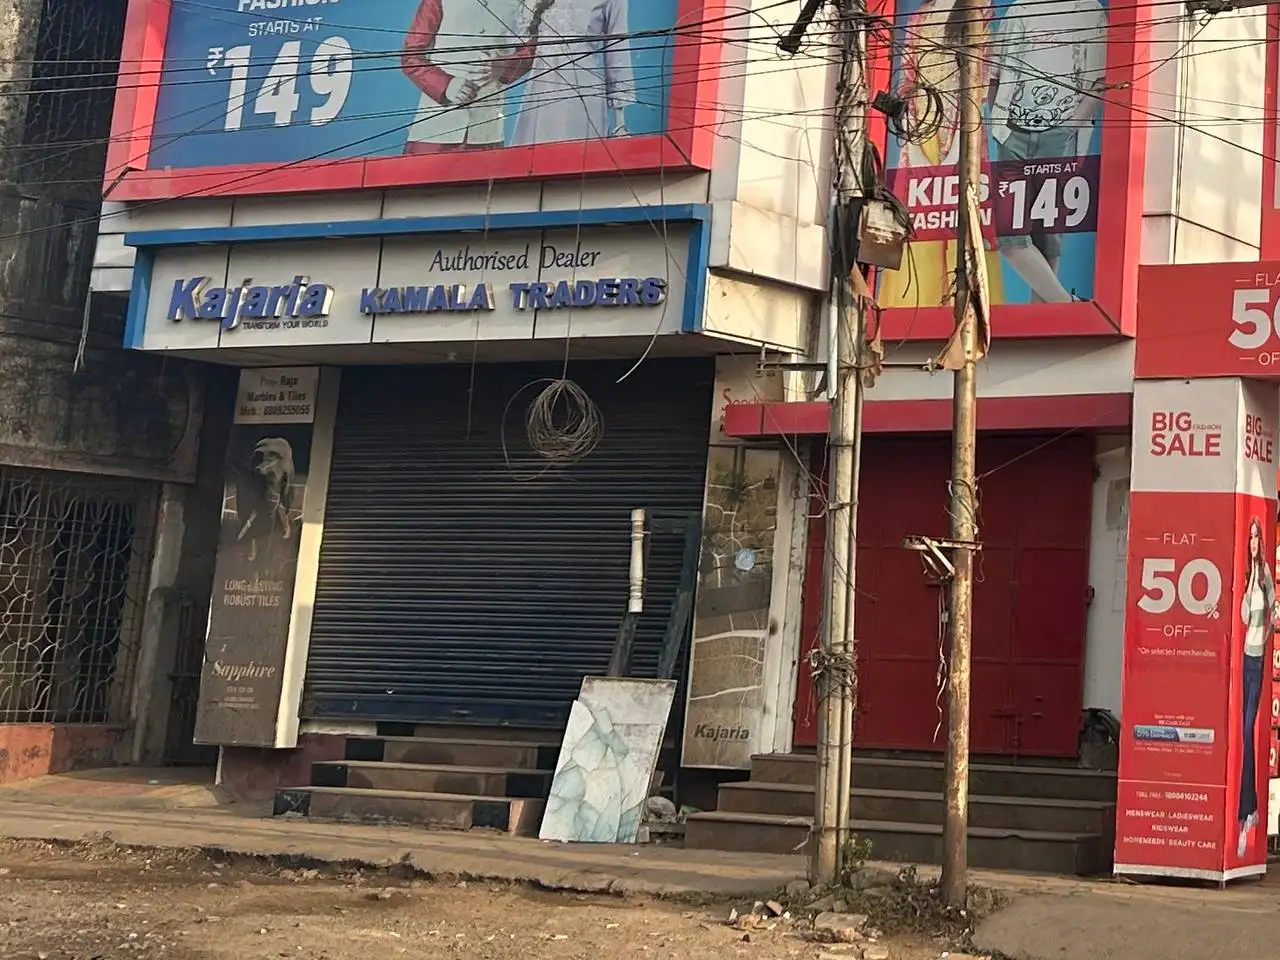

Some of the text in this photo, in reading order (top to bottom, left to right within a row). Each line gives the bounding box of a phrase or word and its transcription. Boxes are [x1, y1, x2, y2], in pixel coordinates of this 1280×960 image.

[248, 16, 323, 37] STARTS AT
[1024, 162, 1078, 175] STARTS AT
[429, 241, 601, 272] Authorised Dealer
[167, 275, 335, 331] Kajaria
[359, 276, 668, 315] KAMALA TRADERS
[282, 320, 300, 329] YOUR
[302, 319, 329, 328] WORLD
[1152, 412, 1192, 432] BIG
[1246, 414, 1262, 436] BIG
[1150, 433, 1221, 456] SALE
[1245, 435, 1273, 463] SALE
[1163, 533, 1197, 545] FLAT
[1163, 624, 1192, 637] OFF
[211, 659, 276, 680] Sapphire
[694, 723, 749, 741] Kajaria
[1126, 809, 1214, 822] MENSWEAR LADIESWEAR
[1151, 824, 1188, 833] KIDSWEAR
[1168, 839, 1196, 848] BEAUTY
[1197, 842, 1217, 850] CARE
